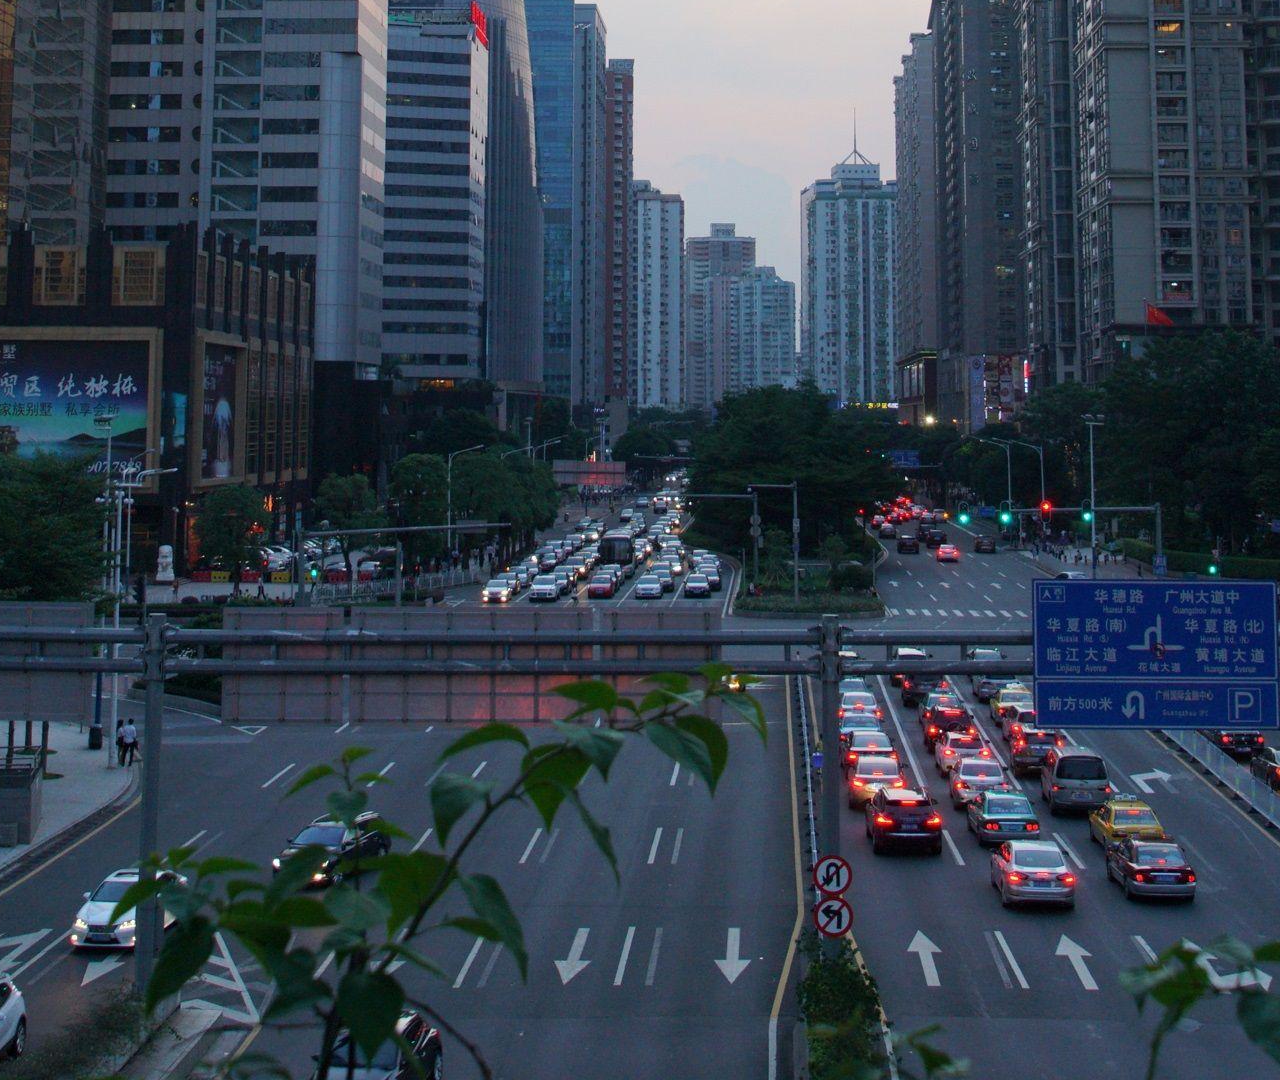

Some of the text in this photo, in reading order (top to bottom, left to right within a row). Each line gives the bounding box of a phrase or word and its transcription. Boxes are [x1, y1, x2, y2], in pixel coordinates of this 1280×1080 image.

[64, 402, 120, 418] 私享会所
[1094, 589, 1145, 604] 华穗路
[1165, 589, 1240, 605] 广州大道中
[1047, 647, 1117, 663] 临江大道
[1196, 648, 1265, 663] 黄埔大道
[1138, 662, 1181, 673] 花城大道
[1048, 697, 1113, 711] 前方500米
[1235, 691, 1254, 719] P
